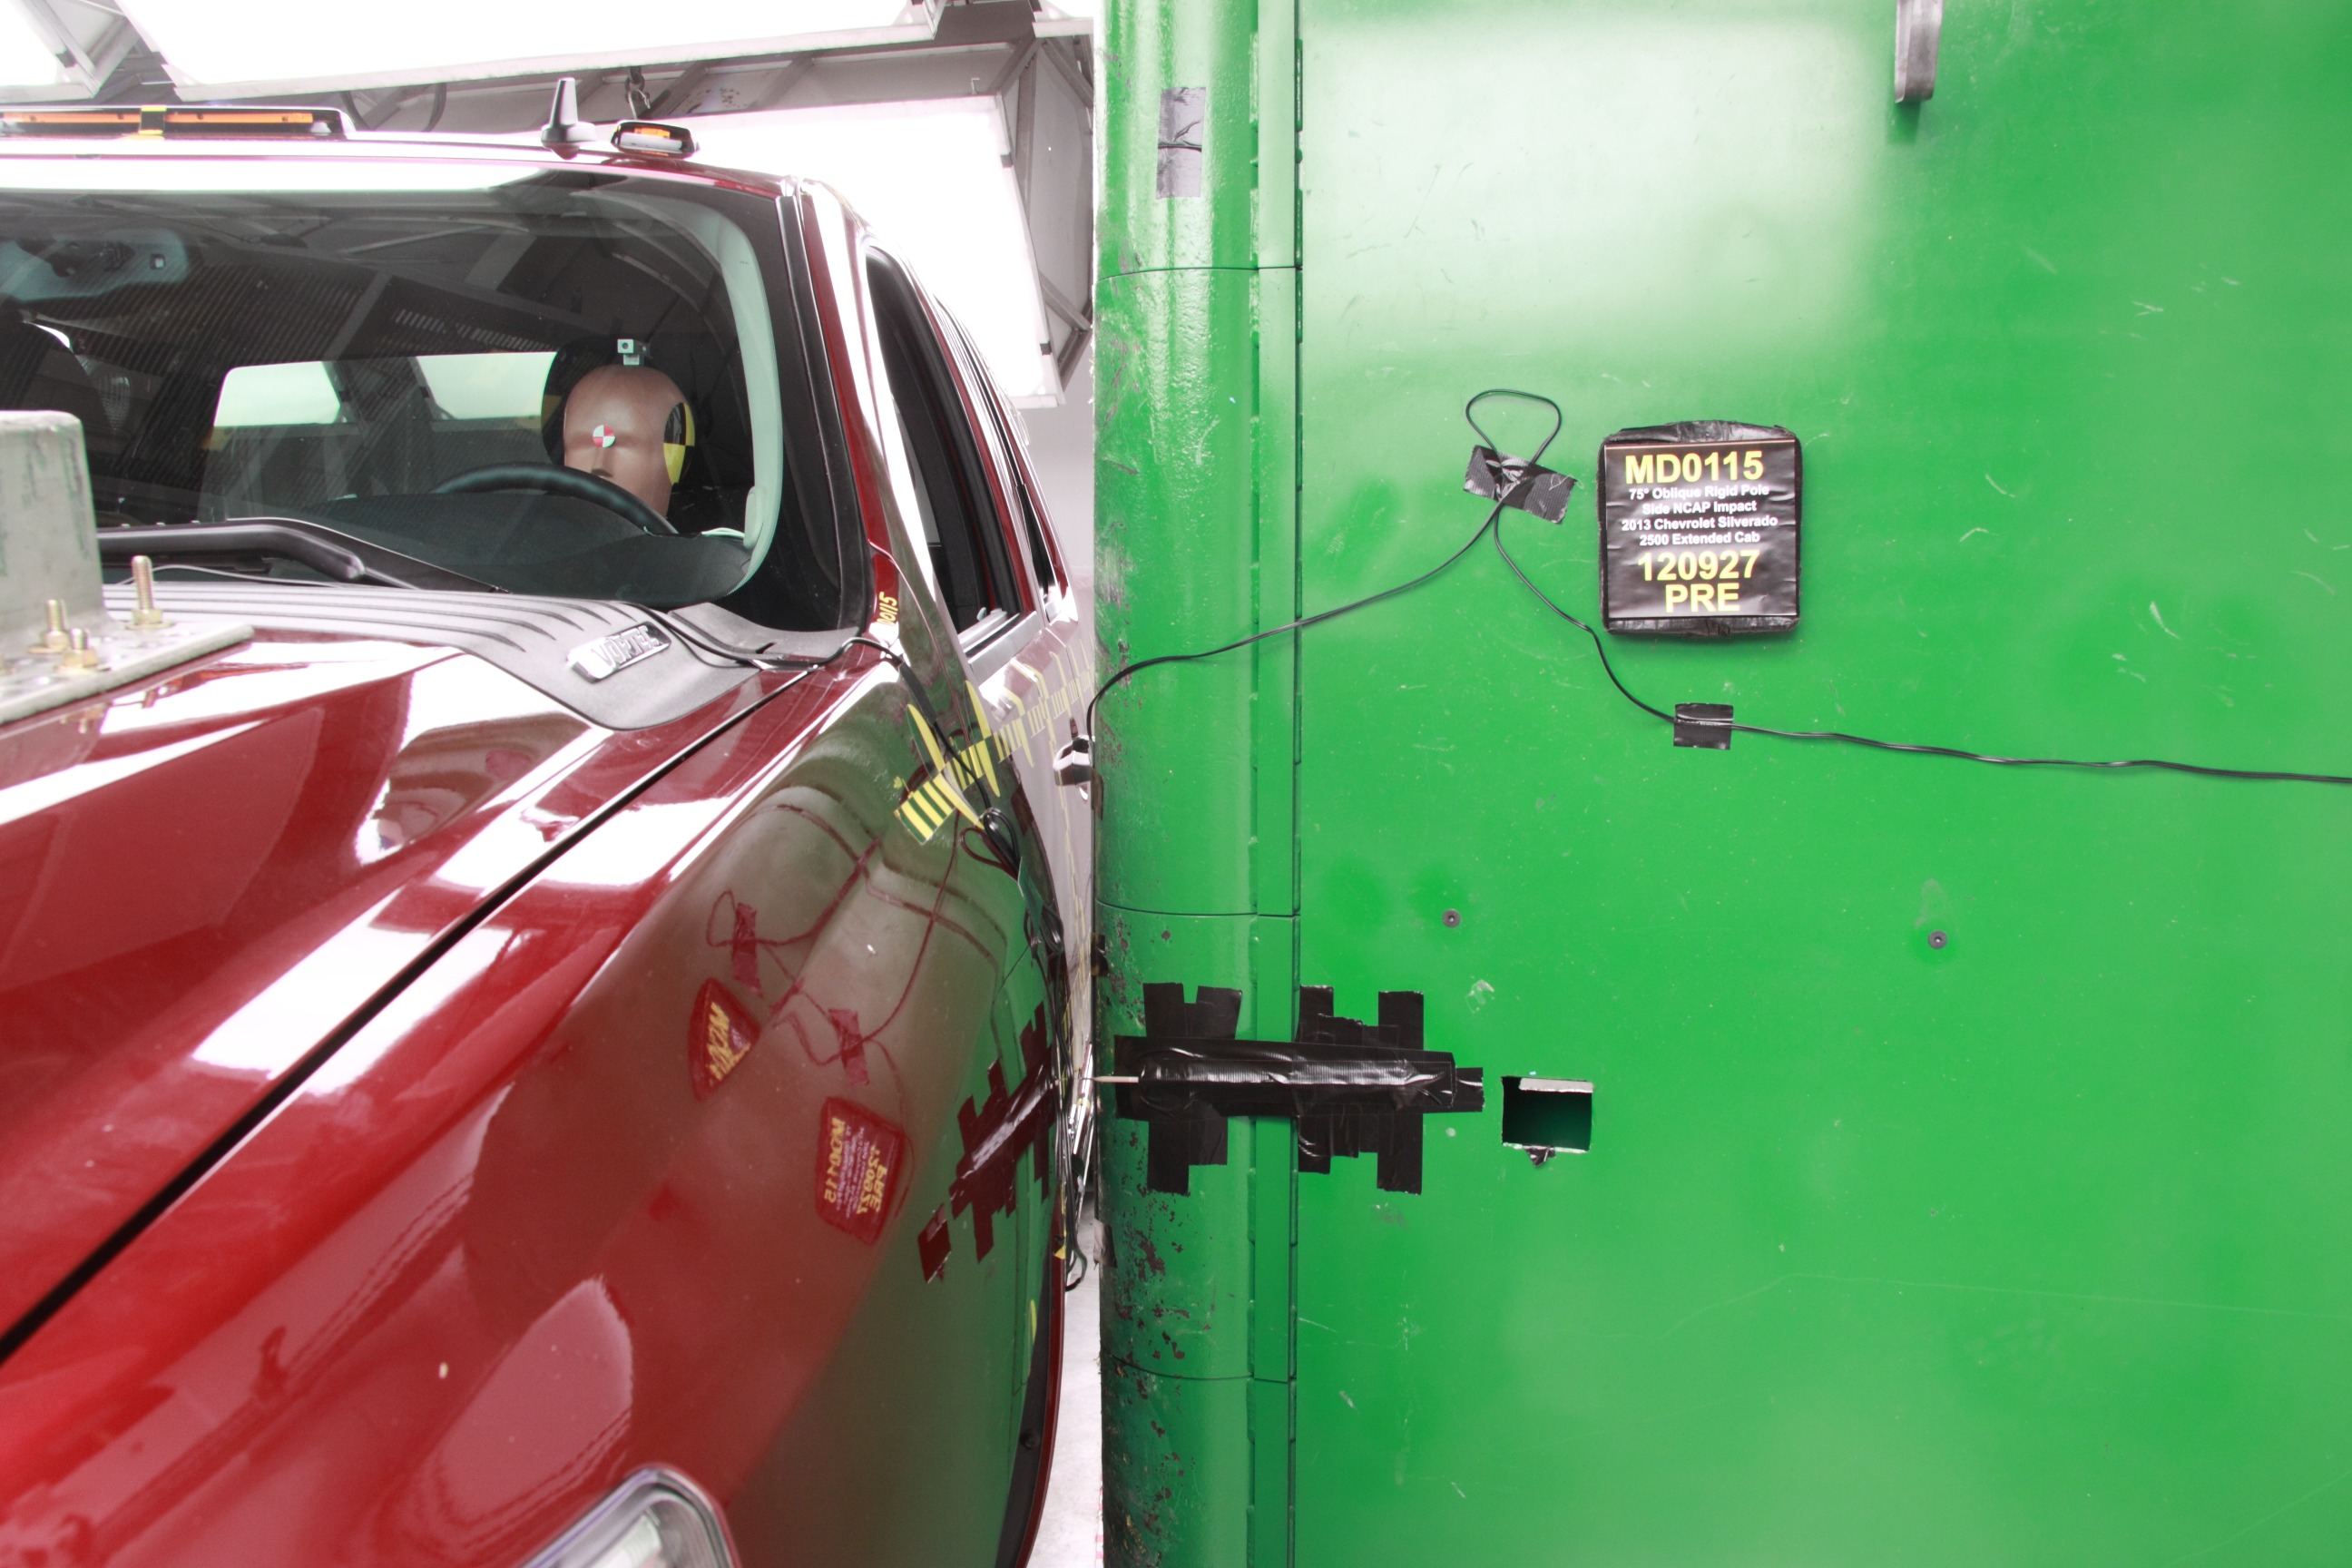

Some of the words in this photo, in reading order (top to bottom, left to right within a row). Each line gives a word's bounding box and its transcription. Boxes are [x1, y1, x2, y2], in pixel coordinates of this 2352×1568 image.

[1625, 450, 1764, 485] MD0115
[1652, 487, 1701, 500] Oblique
[1705, 485, 1737, 499] Rigid
[1740, 485, 1769, 496] Pole
[1642, 503, 1670, 514] Side
[1673, 502, 1710, 514] NCAP
[1713, 500, 1757, 514] Impact
[1622, 519, 1651, 531] 2013
[1654, 517, 1715, 530] Chevrolet
[1718, 515, 1779, 528] Silverado
[1640, 534, 1669, 546] 2500
[1672, 533, 1731, 544] Extended
[1735, 531, 1760, 543] Cab
[1637, 549, 1760, 581] 120927
[1665, 583, 1740, 612] PRE
